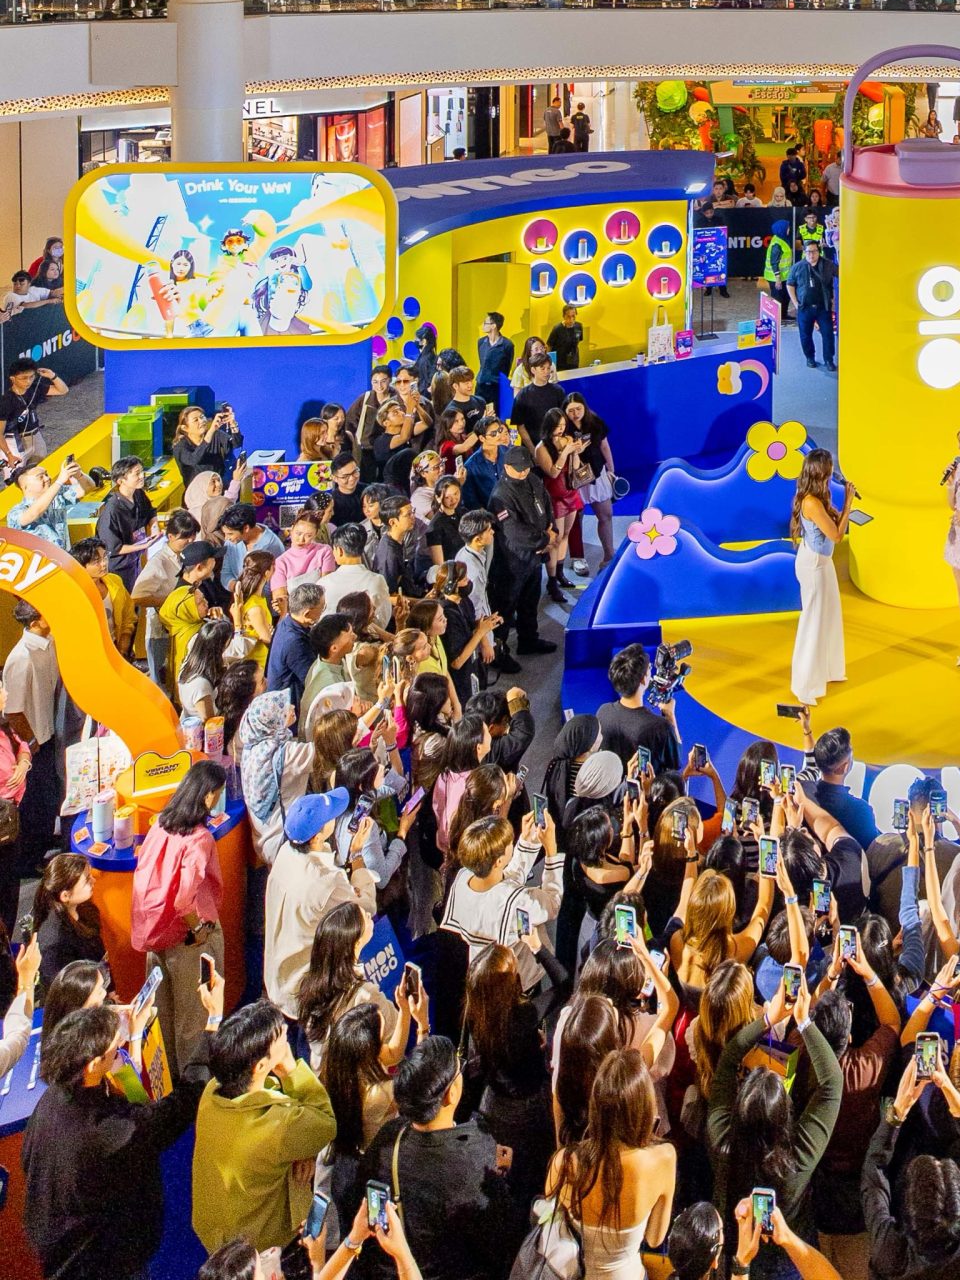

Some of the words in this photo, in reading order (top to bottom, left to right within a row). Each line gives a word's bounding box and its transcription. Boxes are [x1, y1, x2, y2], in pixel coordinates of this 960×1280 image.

[755, 90, 790, 100] Escape
[184, 179, 224, 196] Drink
[228, 179, 259, 194] Your
[261, 181, 292, 195] Way
[365, 942, 395, 976] MON
